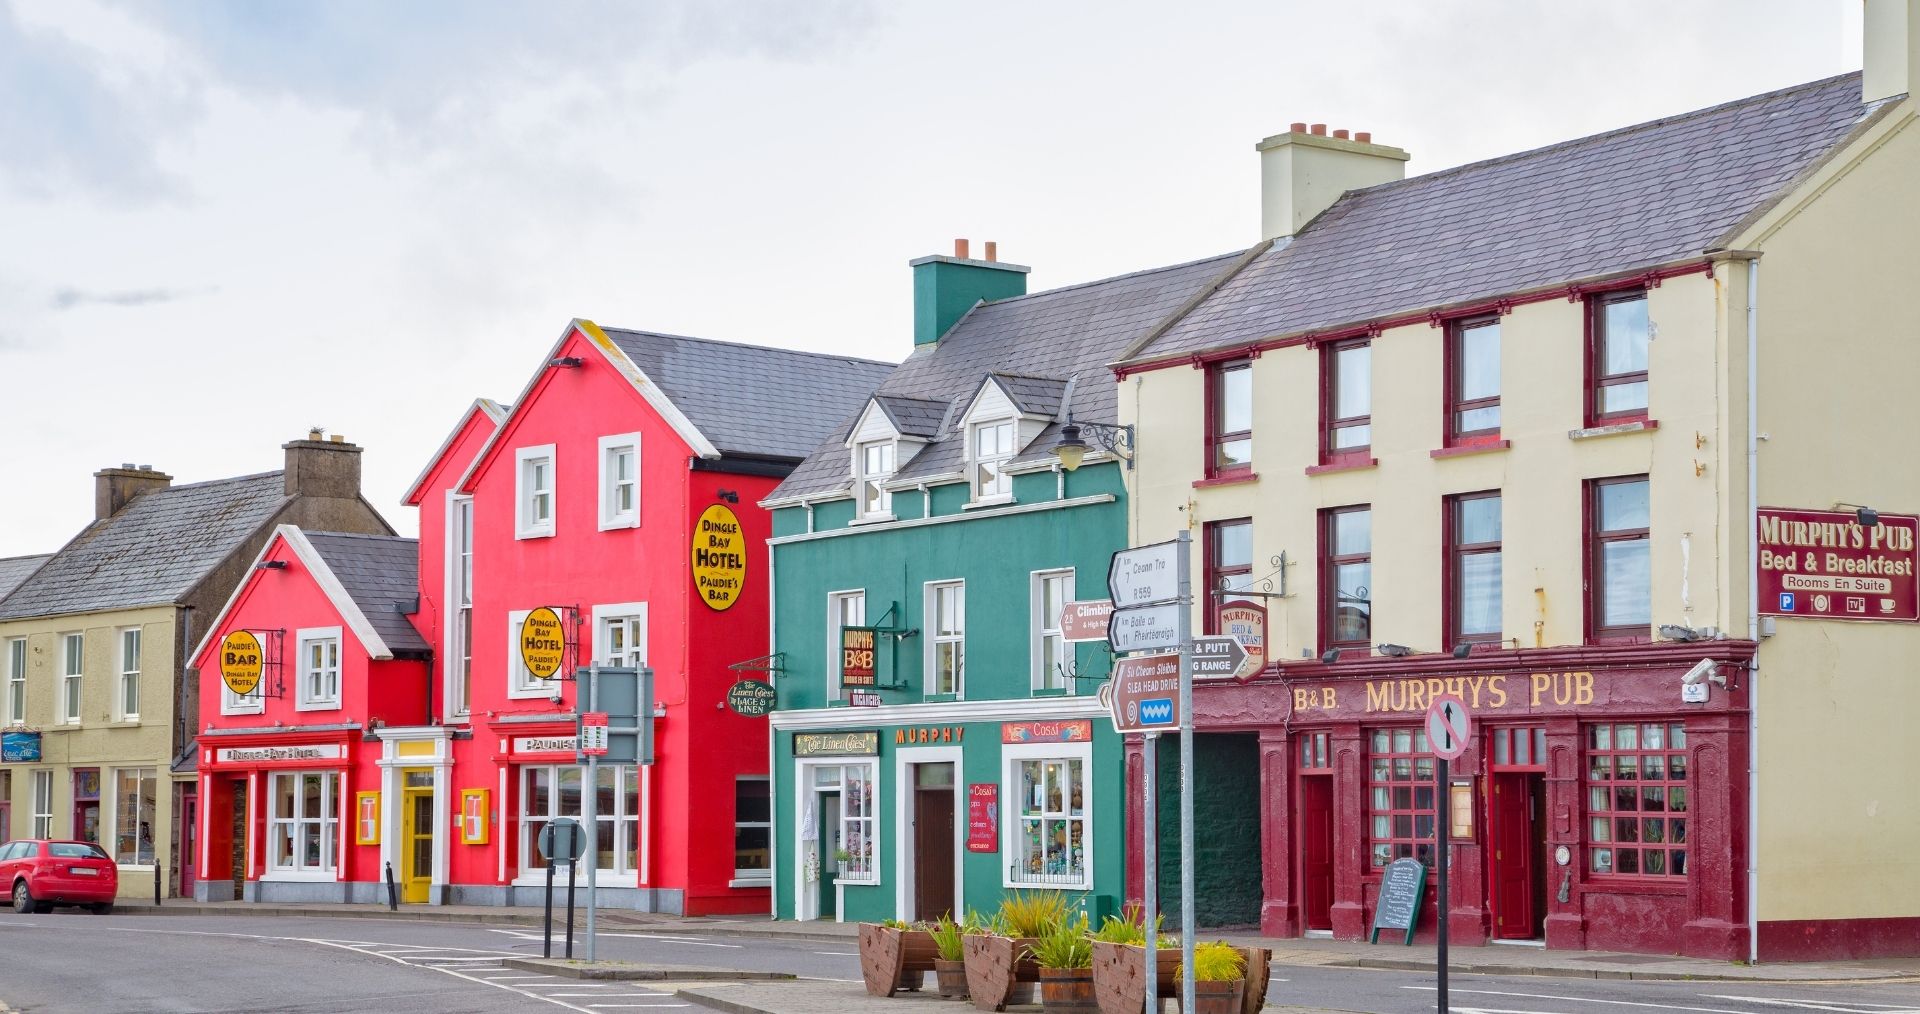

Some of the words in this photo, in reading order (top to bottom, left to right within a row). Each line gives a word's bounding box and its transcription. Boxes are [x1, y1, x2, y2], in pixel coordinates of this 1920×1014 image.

[703, 520, 737, 533] DINGLE
[1759, 516, 1864, 549] MURPHY'S
[1870, 522, 1913, 551] PUB
[709, 535, 730, 548] BAY
[696, 548, 742, 569] HOTEL
[1761, 550, 1797, 571] Bed
[1805, 552, 1817, 571] &
[1826, 553, 1912, 576] Breakfast
[700, 576, 738, 588] PAUDIE'S
[1125, 572, 1130, 584] 7
[1788, 577, 1829, 588] Rooms
[1835, 579, 1849, 589] En
[1856, 580, 1885, 590] Suite
[709, 590, 729, 601] BAR
[1077, 604, 1114, 617] Climbin
[530, 619, 557, 627] DINGLE
[1223, 611, 1262, 624] MURPHY'S
[535, 628, 550, 637] BAY
[1232, 624, 1245, 634] BED
[1247, 625, 1253, 635] &
[227, 642, 255, 650] PAUDIE'S
[525, 637, 561, 651] HOTEL
[1123, 634, 1128, 646] 11
[1195, 644, 1202, 653] &
[1205, 643, 1230, 654] PUTT
[225, 653, 257, 666] BAR
[528, 655, 558, 663] PAUDIE'S
[844, 650, 874, 669] B&B
[1202, 661, 1230, 671] RANGE
[1127, 682, 1142, 693] SLEA
[1143, 680, 1159, 692] HEAD
[1160, 678, 1178, 691] DRIVE
[1365, 675, 1507, 712] MURPHY'S
[1530, 671, 1594, 706] PUB
[852, 693, 880, 706] VACANCIES
[895, 727, 963, 744] MURPHY
[804, 735, 821, 752] The
[822, 736, 845, 750] Linen
[845, 734, 866, 751] Chest
